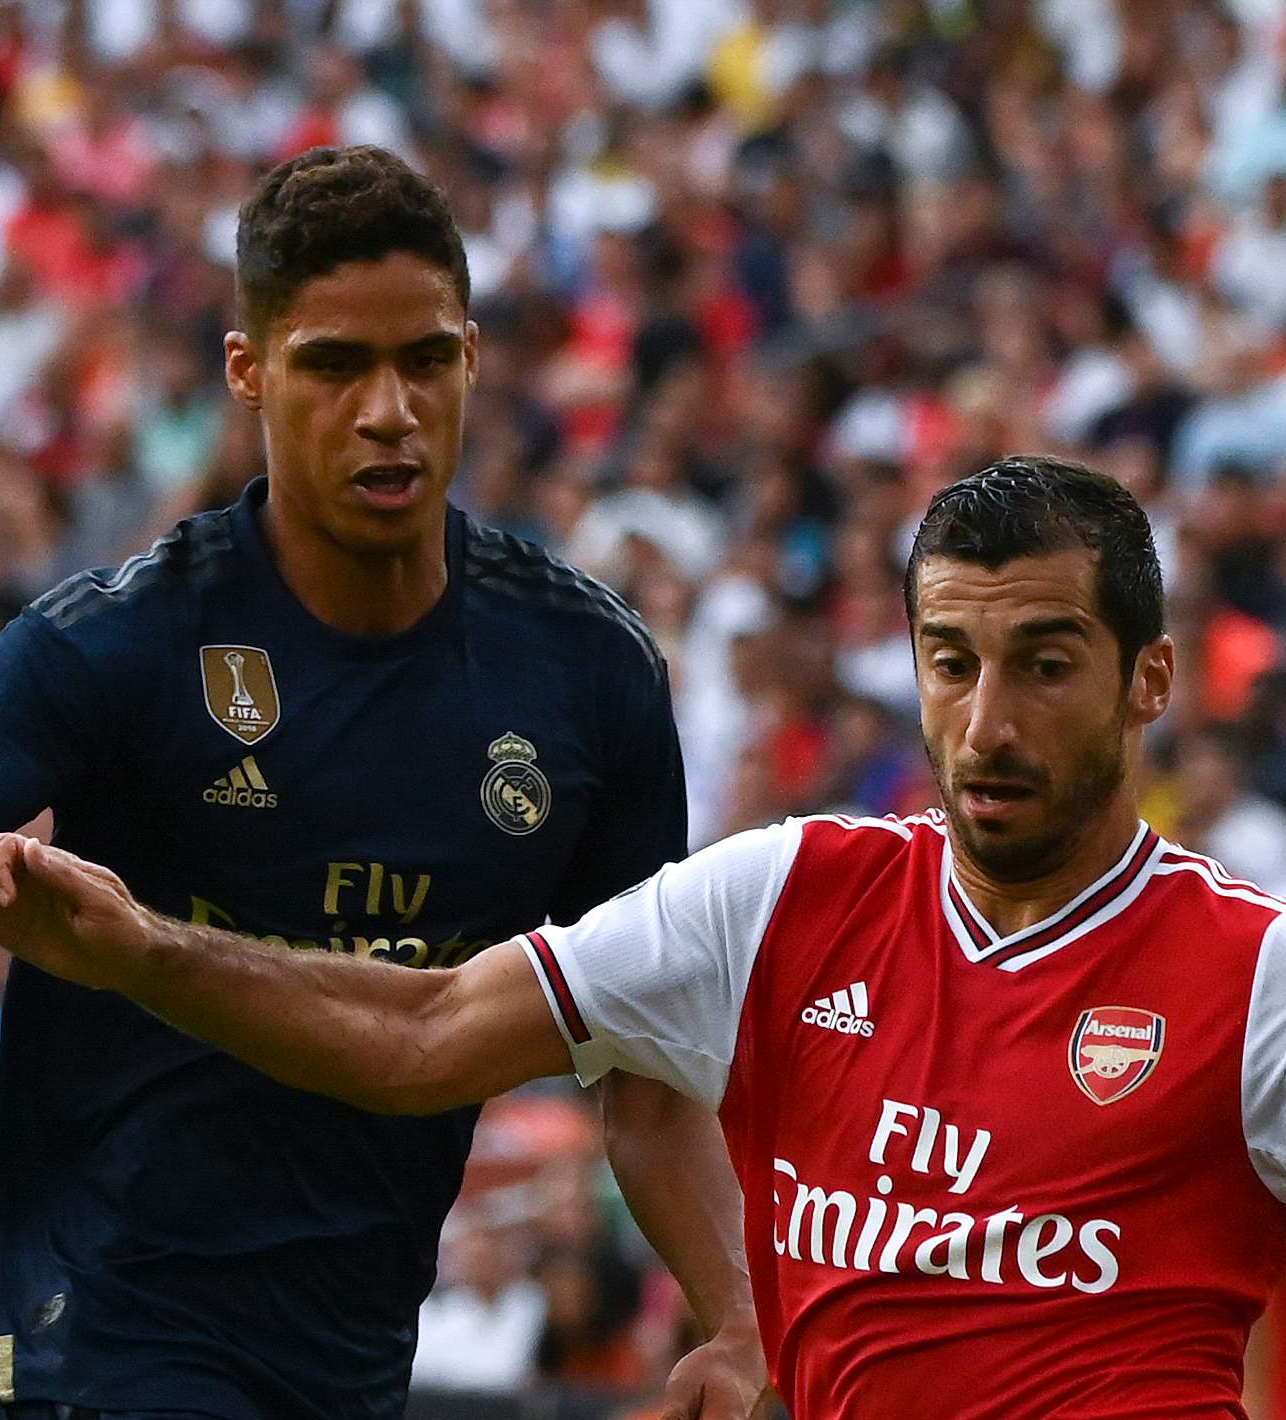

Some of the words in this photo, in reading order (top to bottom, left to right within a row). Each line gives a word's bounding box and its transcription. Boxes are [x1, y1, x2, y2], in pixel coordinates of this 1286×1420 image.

[228, 705, 262, 720] FIFA
[202, 787, 278, 808] adidas
[323, 862, 432, 924] Fly
[801, 1007, 875, 1038] adidas
[1084, 1018, 1152, 1041] Arsenal
[869, 1099, 992, 1194] Fly
